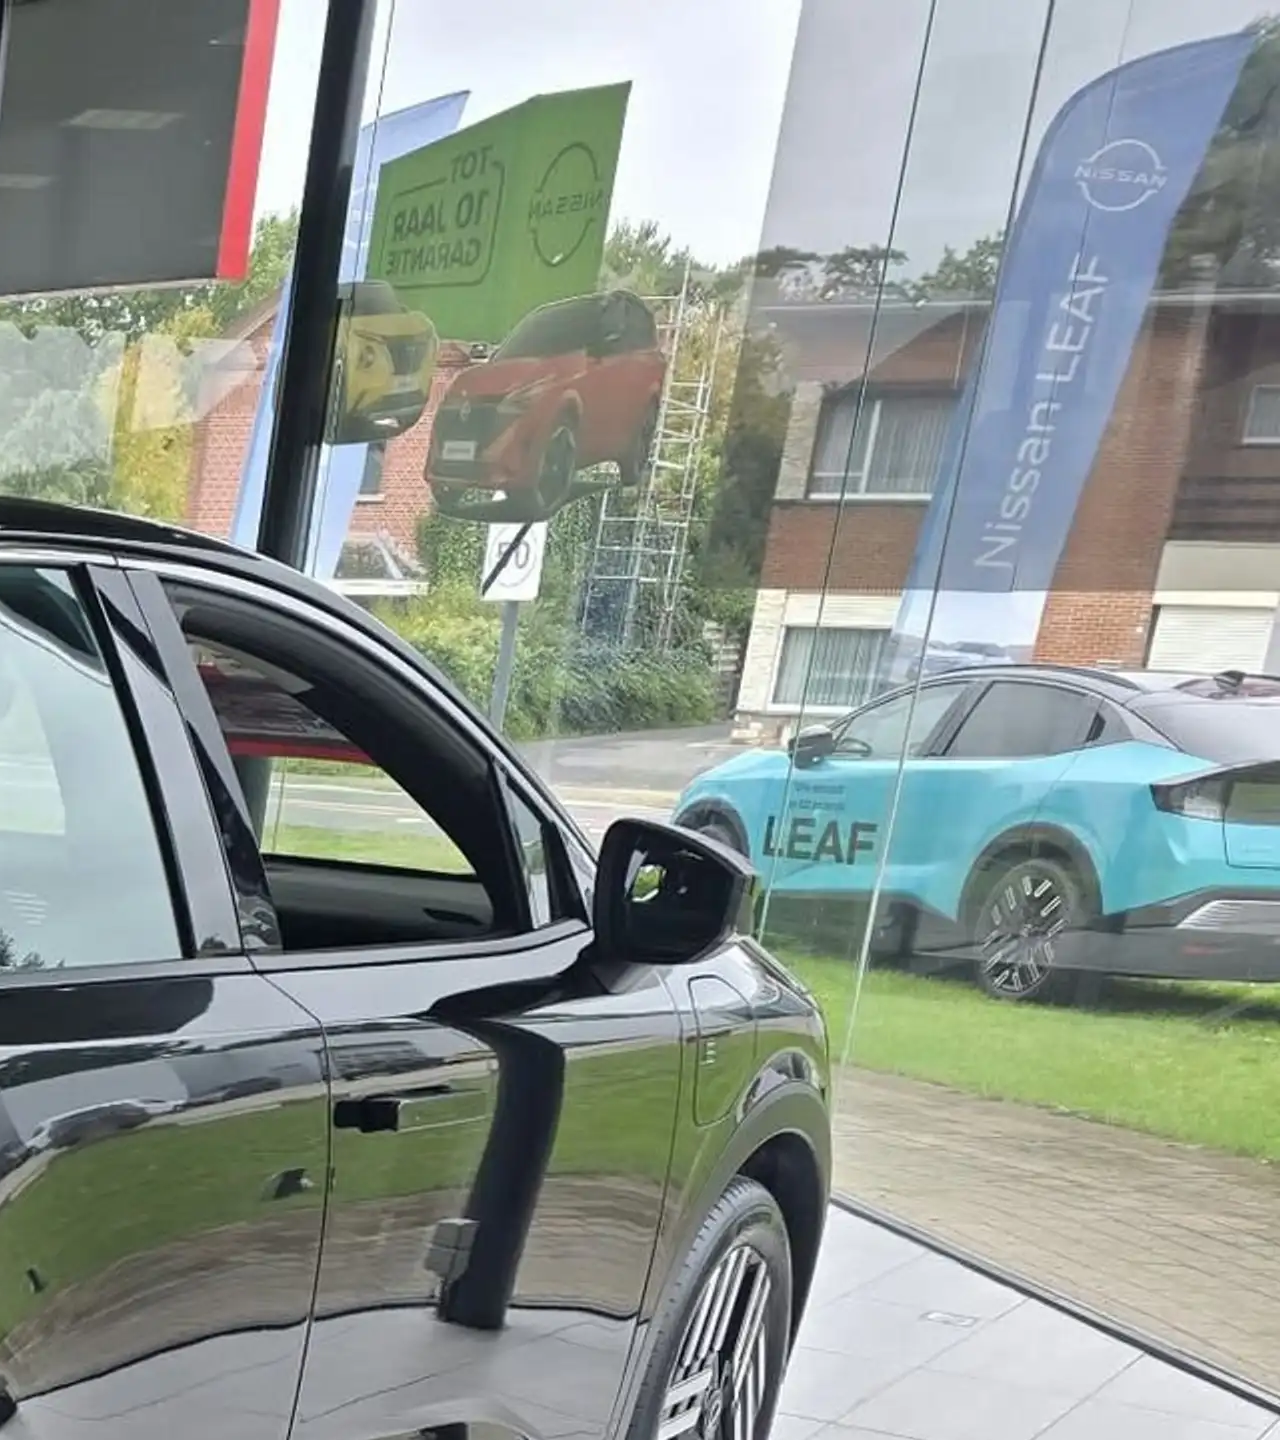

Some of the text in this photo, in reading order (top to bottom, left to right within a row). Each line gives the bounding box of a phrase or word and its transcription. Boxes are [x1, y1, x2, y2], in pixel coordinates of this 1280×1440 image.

[1073, 163, 1168, 194] NISSAN
[973, 251, 1109, 568] Nissan LEAF
[762, 815, 878, 866] LEAF
